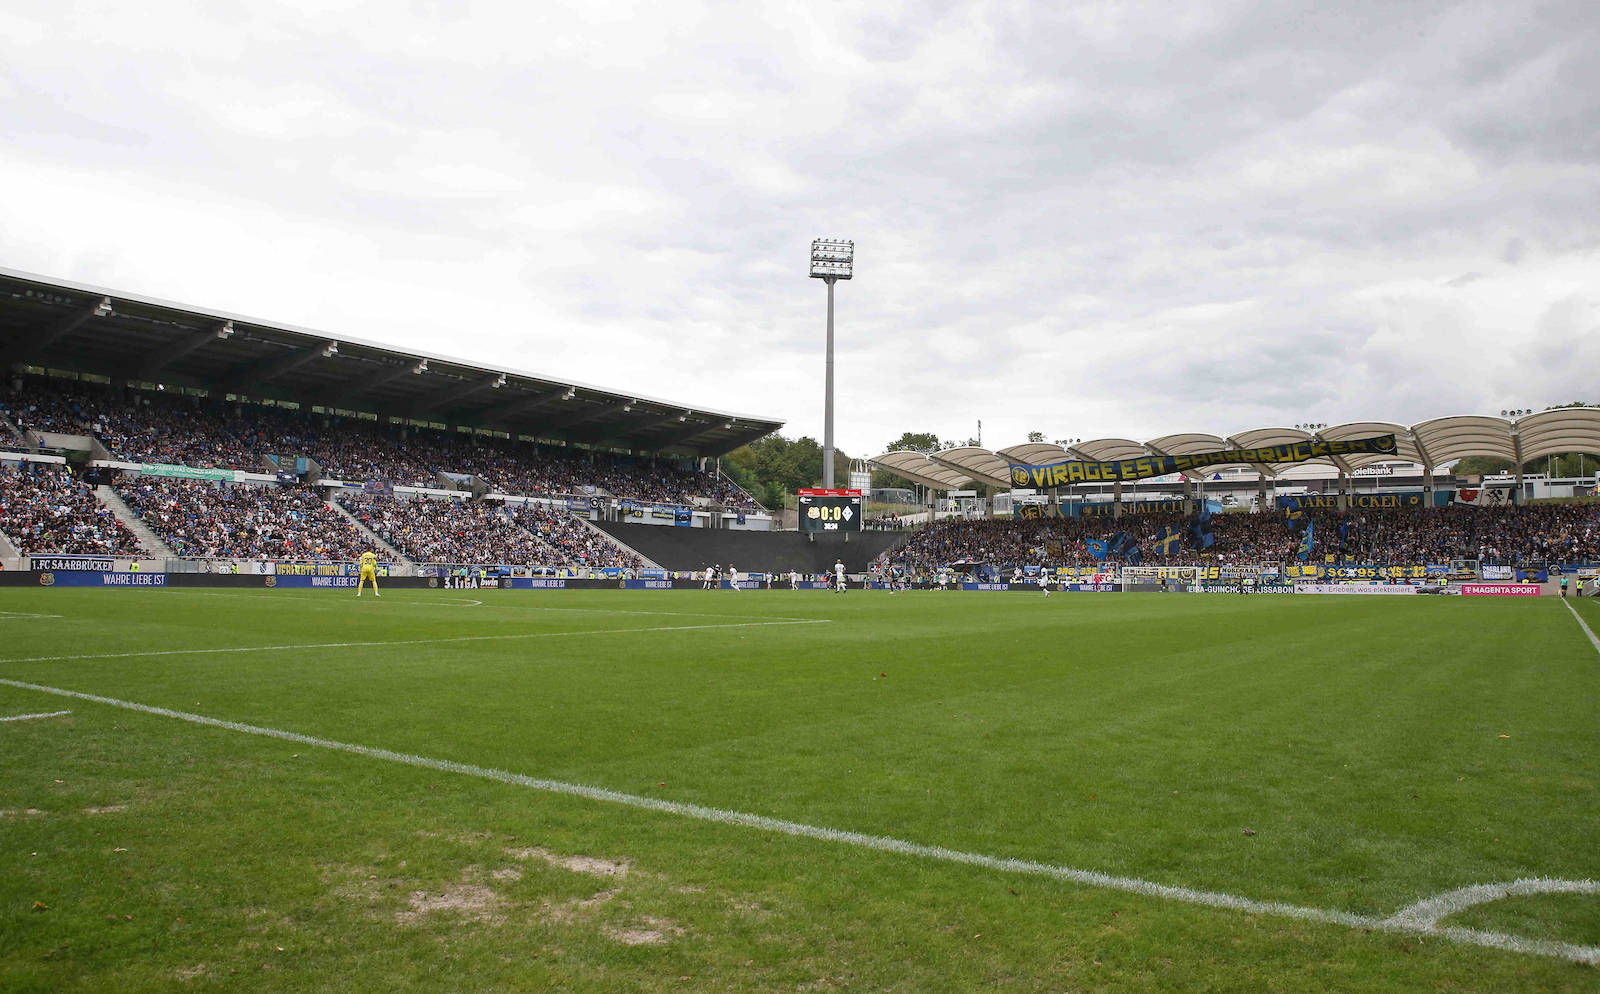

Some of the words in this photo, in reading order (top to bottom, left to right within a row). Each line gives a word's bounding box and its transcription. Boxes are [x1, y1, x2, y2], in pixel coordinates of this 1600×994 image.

[1031, 461, 1118, 488] VIRAGE
[1120, 456, 1168, 480] EST
[821, 506, 841, 520] 0:0
[1328, 568, 1346, 577] SC
[1358, 568, 1376, 577] 95
[103, 574, 130, 584] WAHRE
[132, 574, 152, 585] LIEBE
[154, 574, 165, 585] IST
[312, 577, 332, 586] WAHRE
[333, 577, 349, 586] LIEBE
[350, 577, 359, 586] IST
[480, 578, 498, 586] bwin
[1328, 586, 1356, 594] Erleben,
[1472, 586, 1511, 594] MAGENTA
[1511, 586, 1537, 594] SPORT
